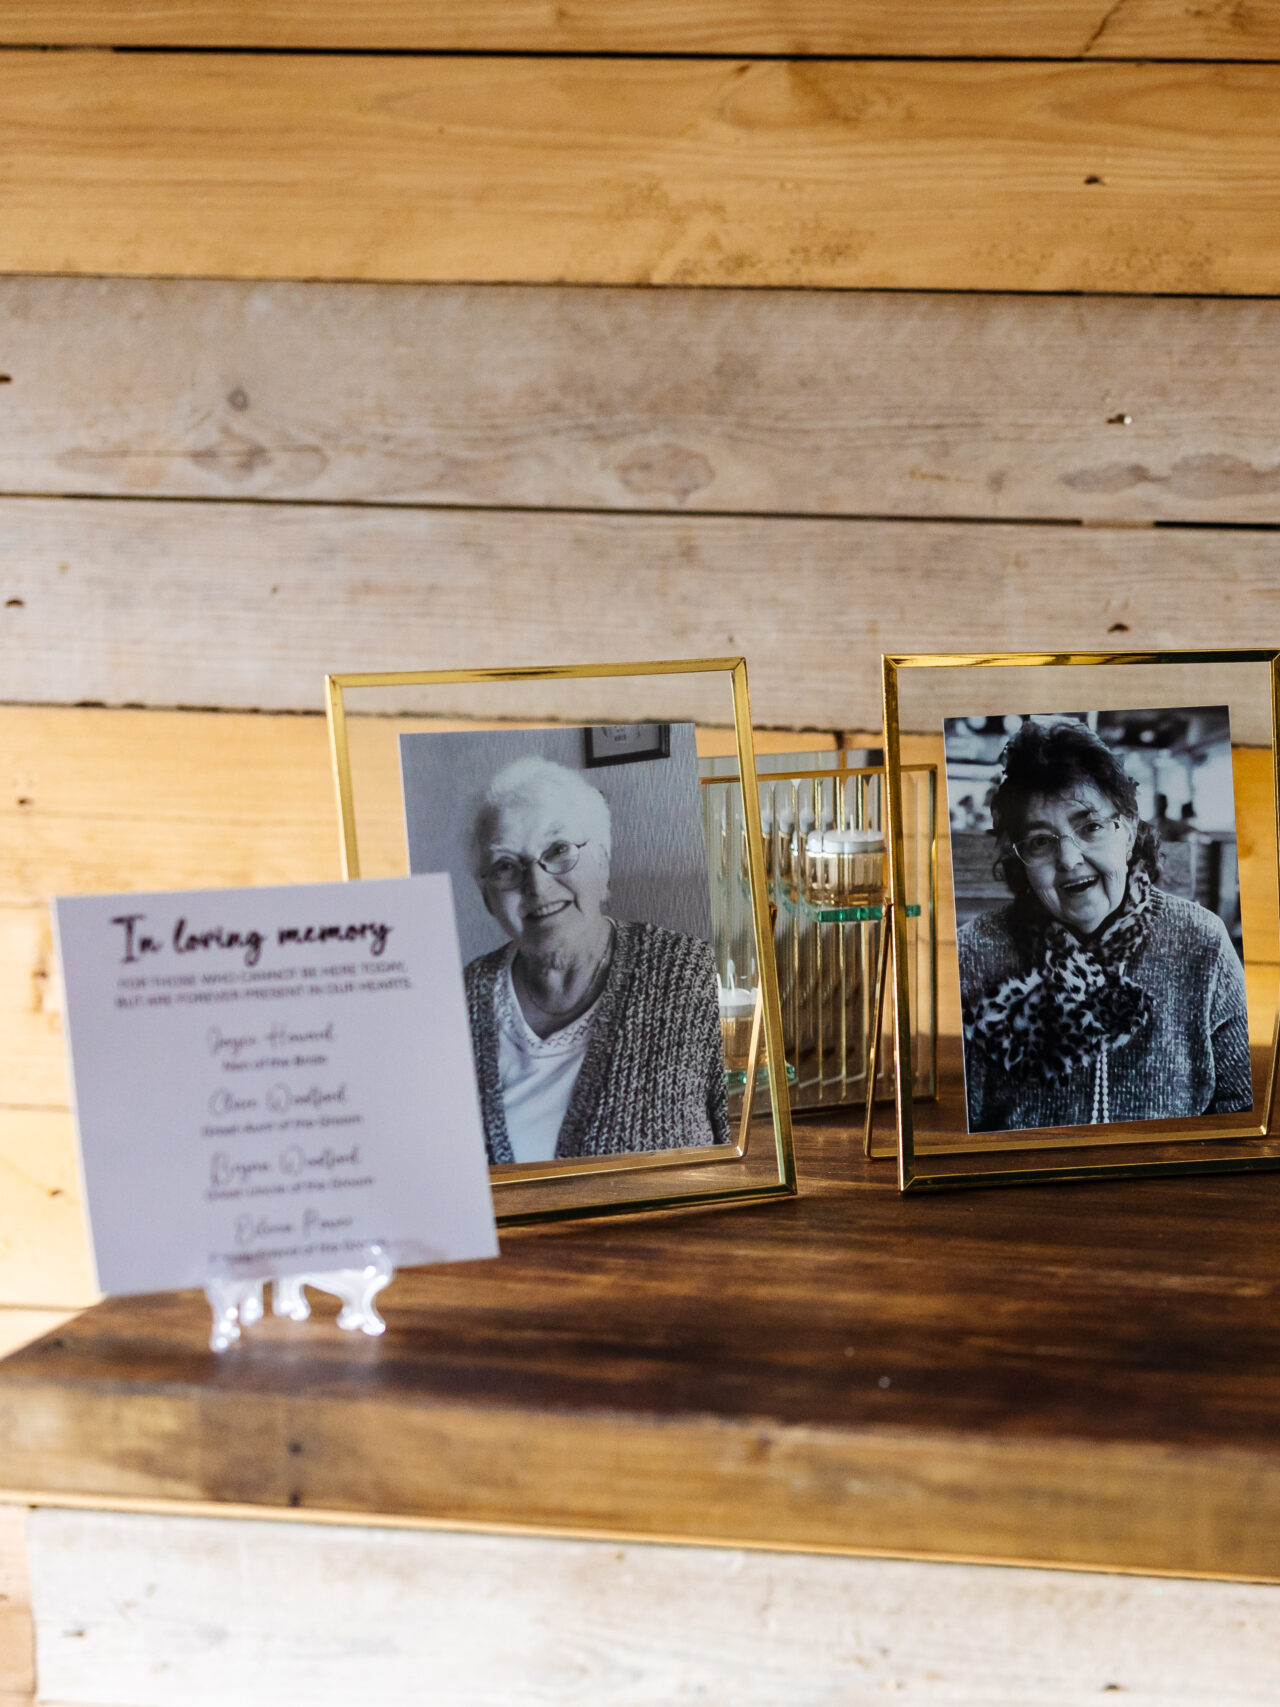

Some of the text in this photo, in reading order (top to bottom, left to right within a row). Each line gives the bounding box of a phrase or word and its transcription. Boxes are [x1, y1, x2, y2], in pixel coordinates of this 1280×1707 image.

[110, 914, 394, 966] In loving memory
